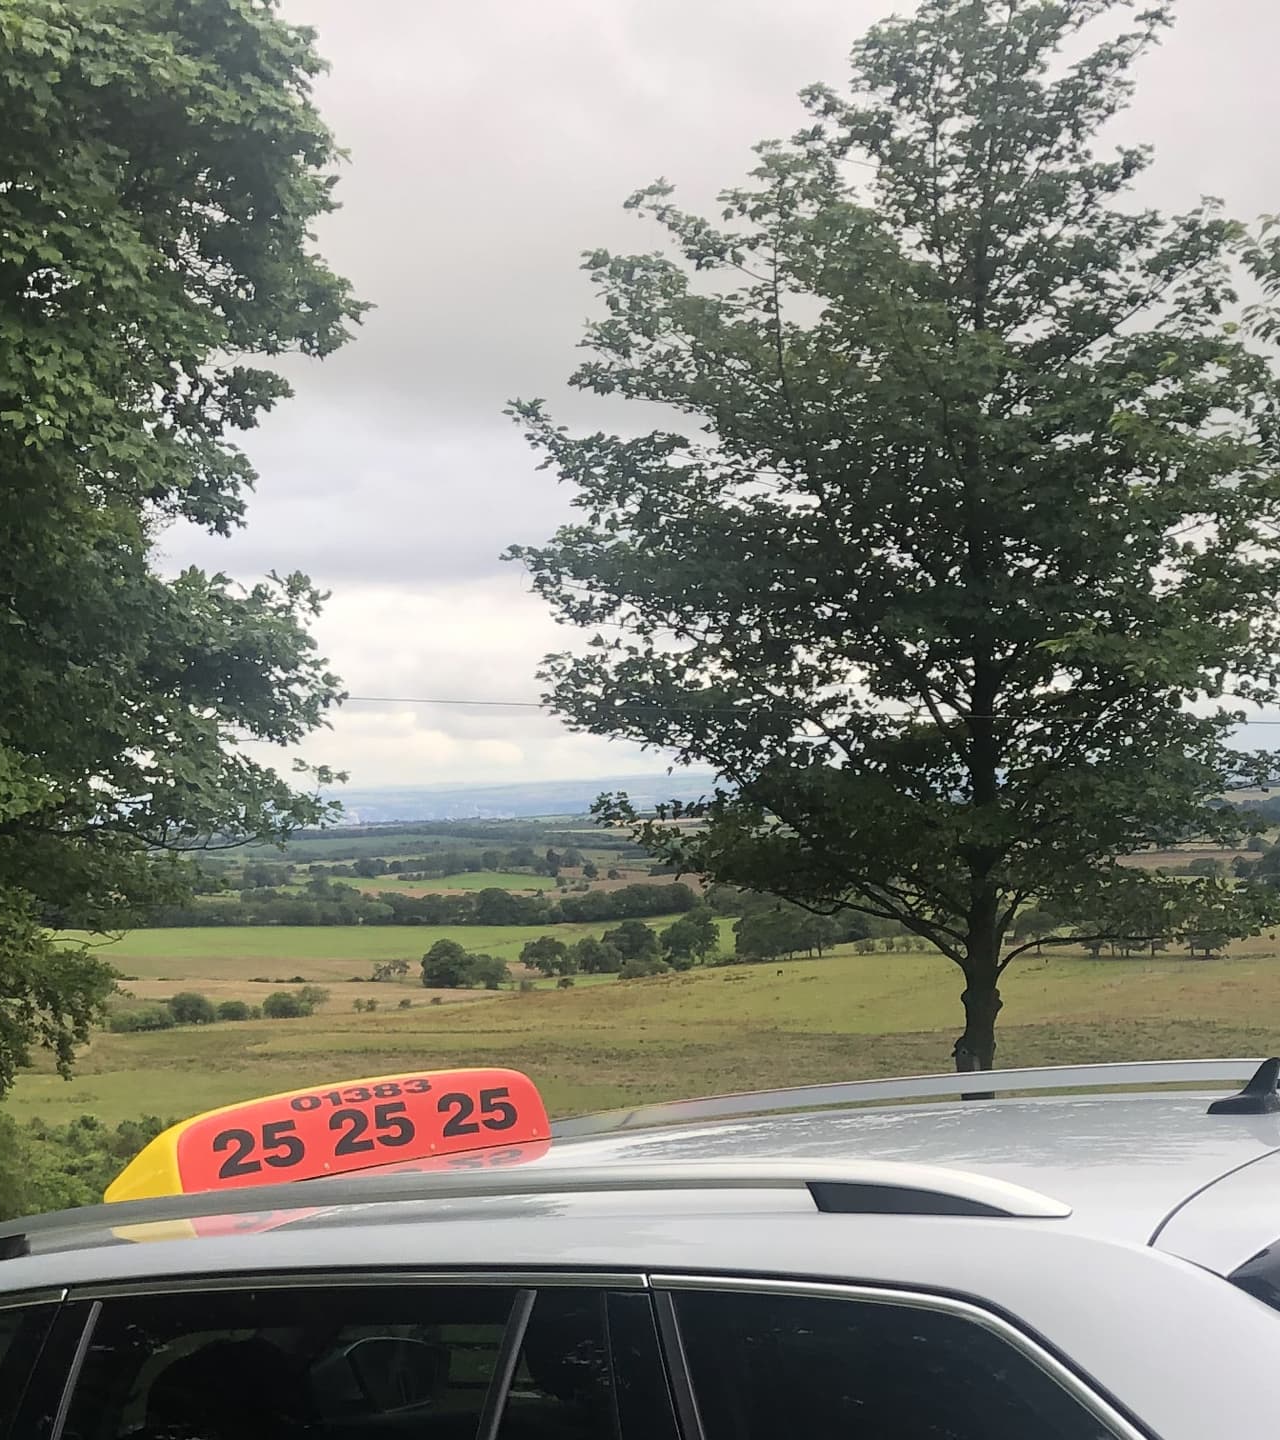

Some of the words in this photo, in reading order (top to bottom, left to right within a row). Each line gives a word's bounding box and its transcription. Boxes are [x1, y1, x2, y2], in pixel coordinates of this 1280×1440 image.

[291, 1079, 432, 1112] 01383
[212, 1121, 306, 1179] 25
[328, 1102, 416, 1156] 25
[437, 1087, 518, 1138] 25
